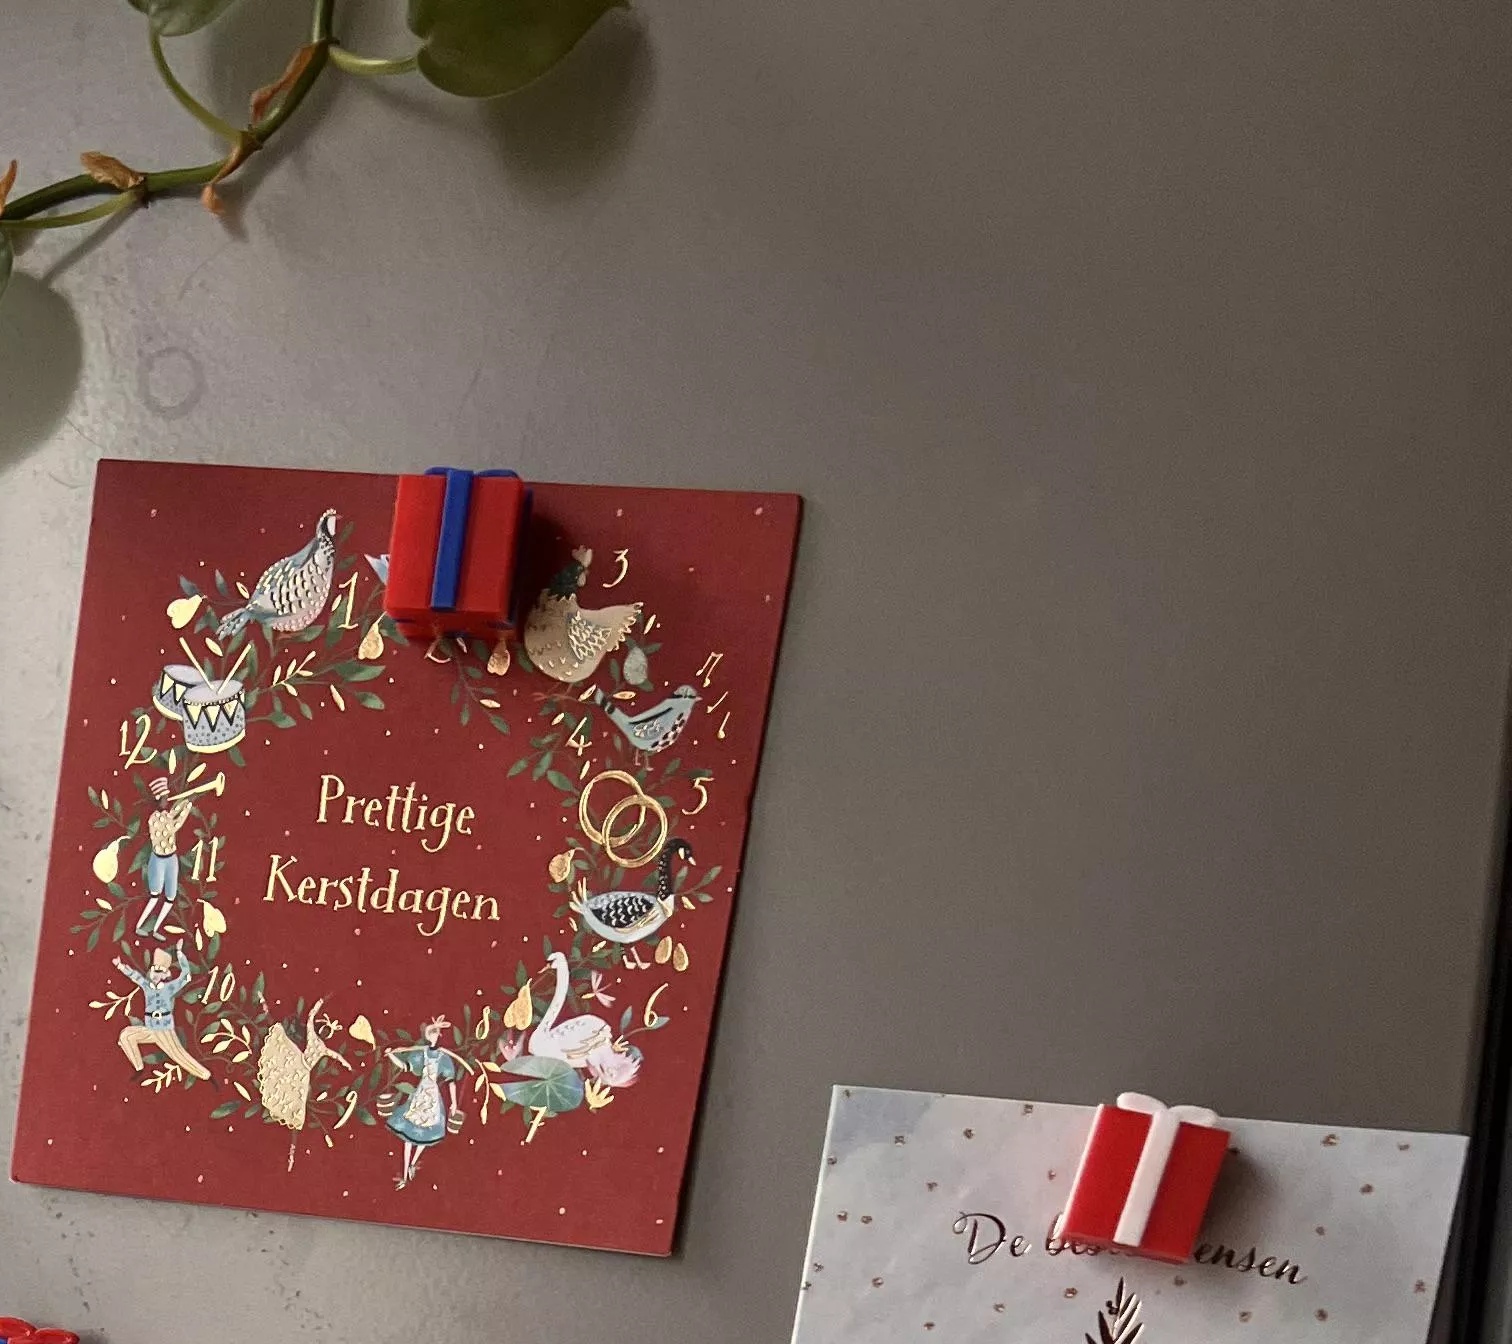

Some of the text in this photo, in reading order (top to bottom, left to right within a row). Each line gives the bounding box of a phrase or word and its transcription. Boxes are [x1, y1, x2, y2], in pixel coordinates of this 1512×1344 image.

[603, 549, 629, 588] 3
[338, 571, 358, 629] 1
[120, 715, 157, 768] 12
[566, 717, 592, 756] 4
[317, 775, 475, 852] Prettige
[682, 777, 709, 815] 5
[191, 838, 218, 882] 11
[263, 856, 500, 936] Kerstdagen
[205, 968, 235, 1004] 10
[644, 984, 669, 1027] 6
[335, 1092, 357, 1128] 9
[525, 1107, 550, 1143] 7
[952, 1212, 1032, 1264] De
[1195, 1241, 1308, 1285] ensen
